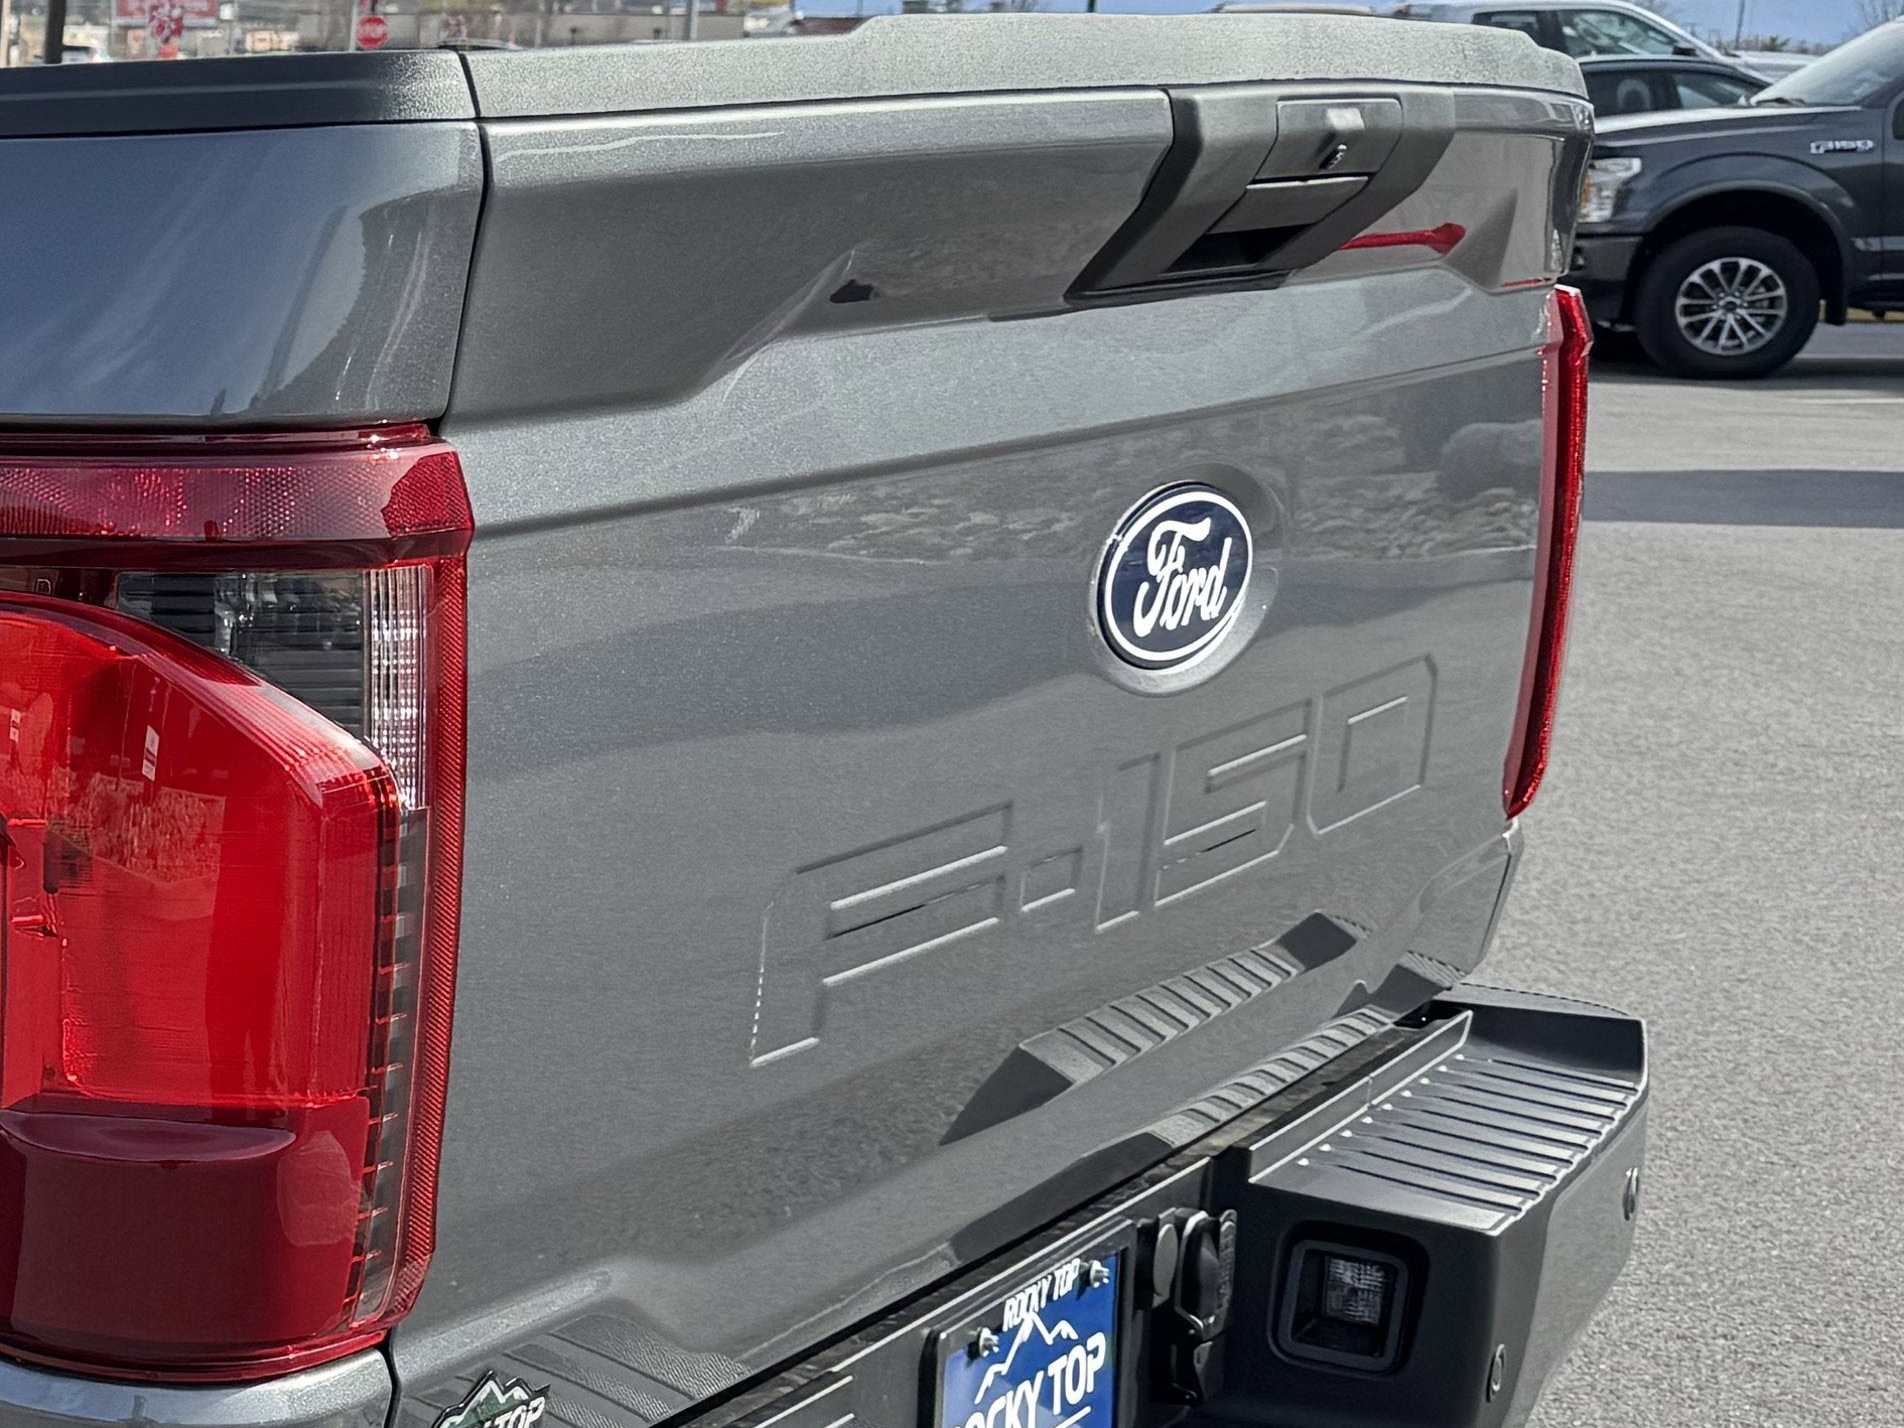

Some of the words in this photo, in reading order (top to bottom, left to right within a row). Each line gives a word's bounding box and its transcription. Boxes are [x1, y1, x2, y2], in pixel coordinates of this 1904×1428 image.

[1133, 517, 1232, 637] Ford
[750, 653, 1438, 1067] F-150
[1003, 1273, 1051, 1332] ROCKY
[1053, 1258, 1081, 1300] TOP
[1048, 1332, 1106, 1415] TOP
